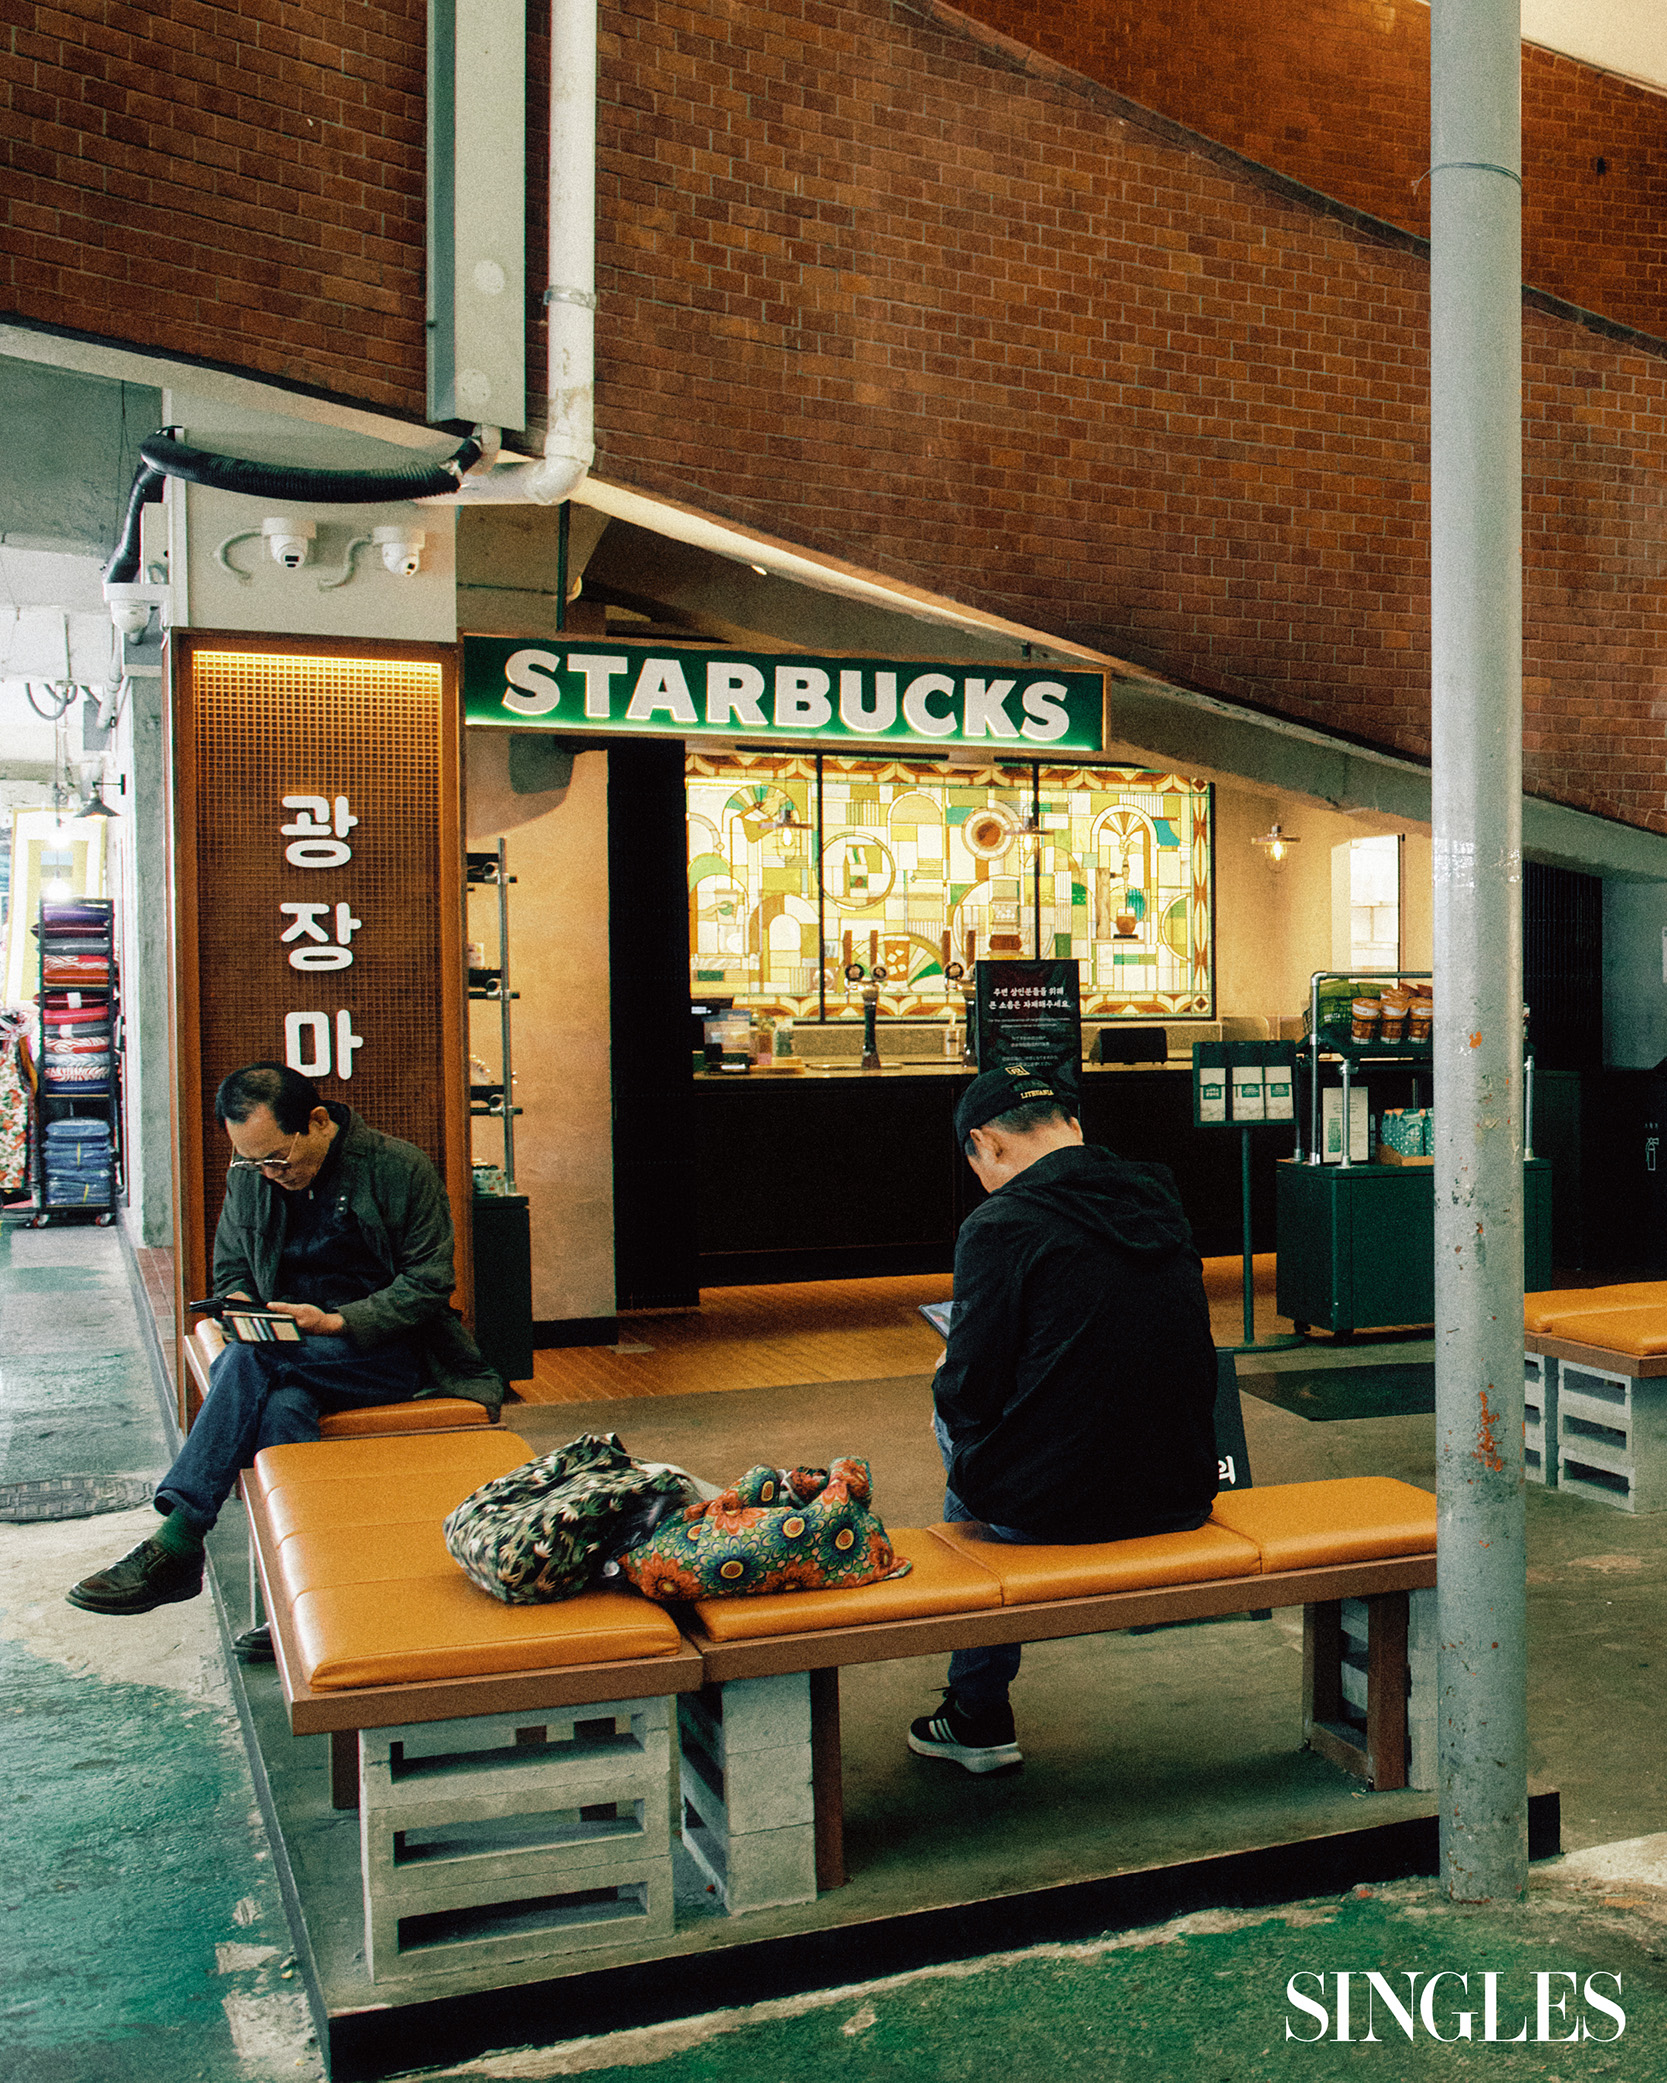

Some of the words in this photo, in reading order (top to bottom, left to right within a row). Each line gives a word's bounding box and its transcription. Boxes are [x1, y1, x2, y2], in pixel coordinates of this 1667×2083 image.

[501, 648, 1070, 741] STARBUCKS
[993, 988, 1009, 997] 주변
[1049, 986, 1064, 996] 위해
[998, 1000, 1021, 1010] 소음은
[1020, 1089, 1054, 1099] LITHUANIA
